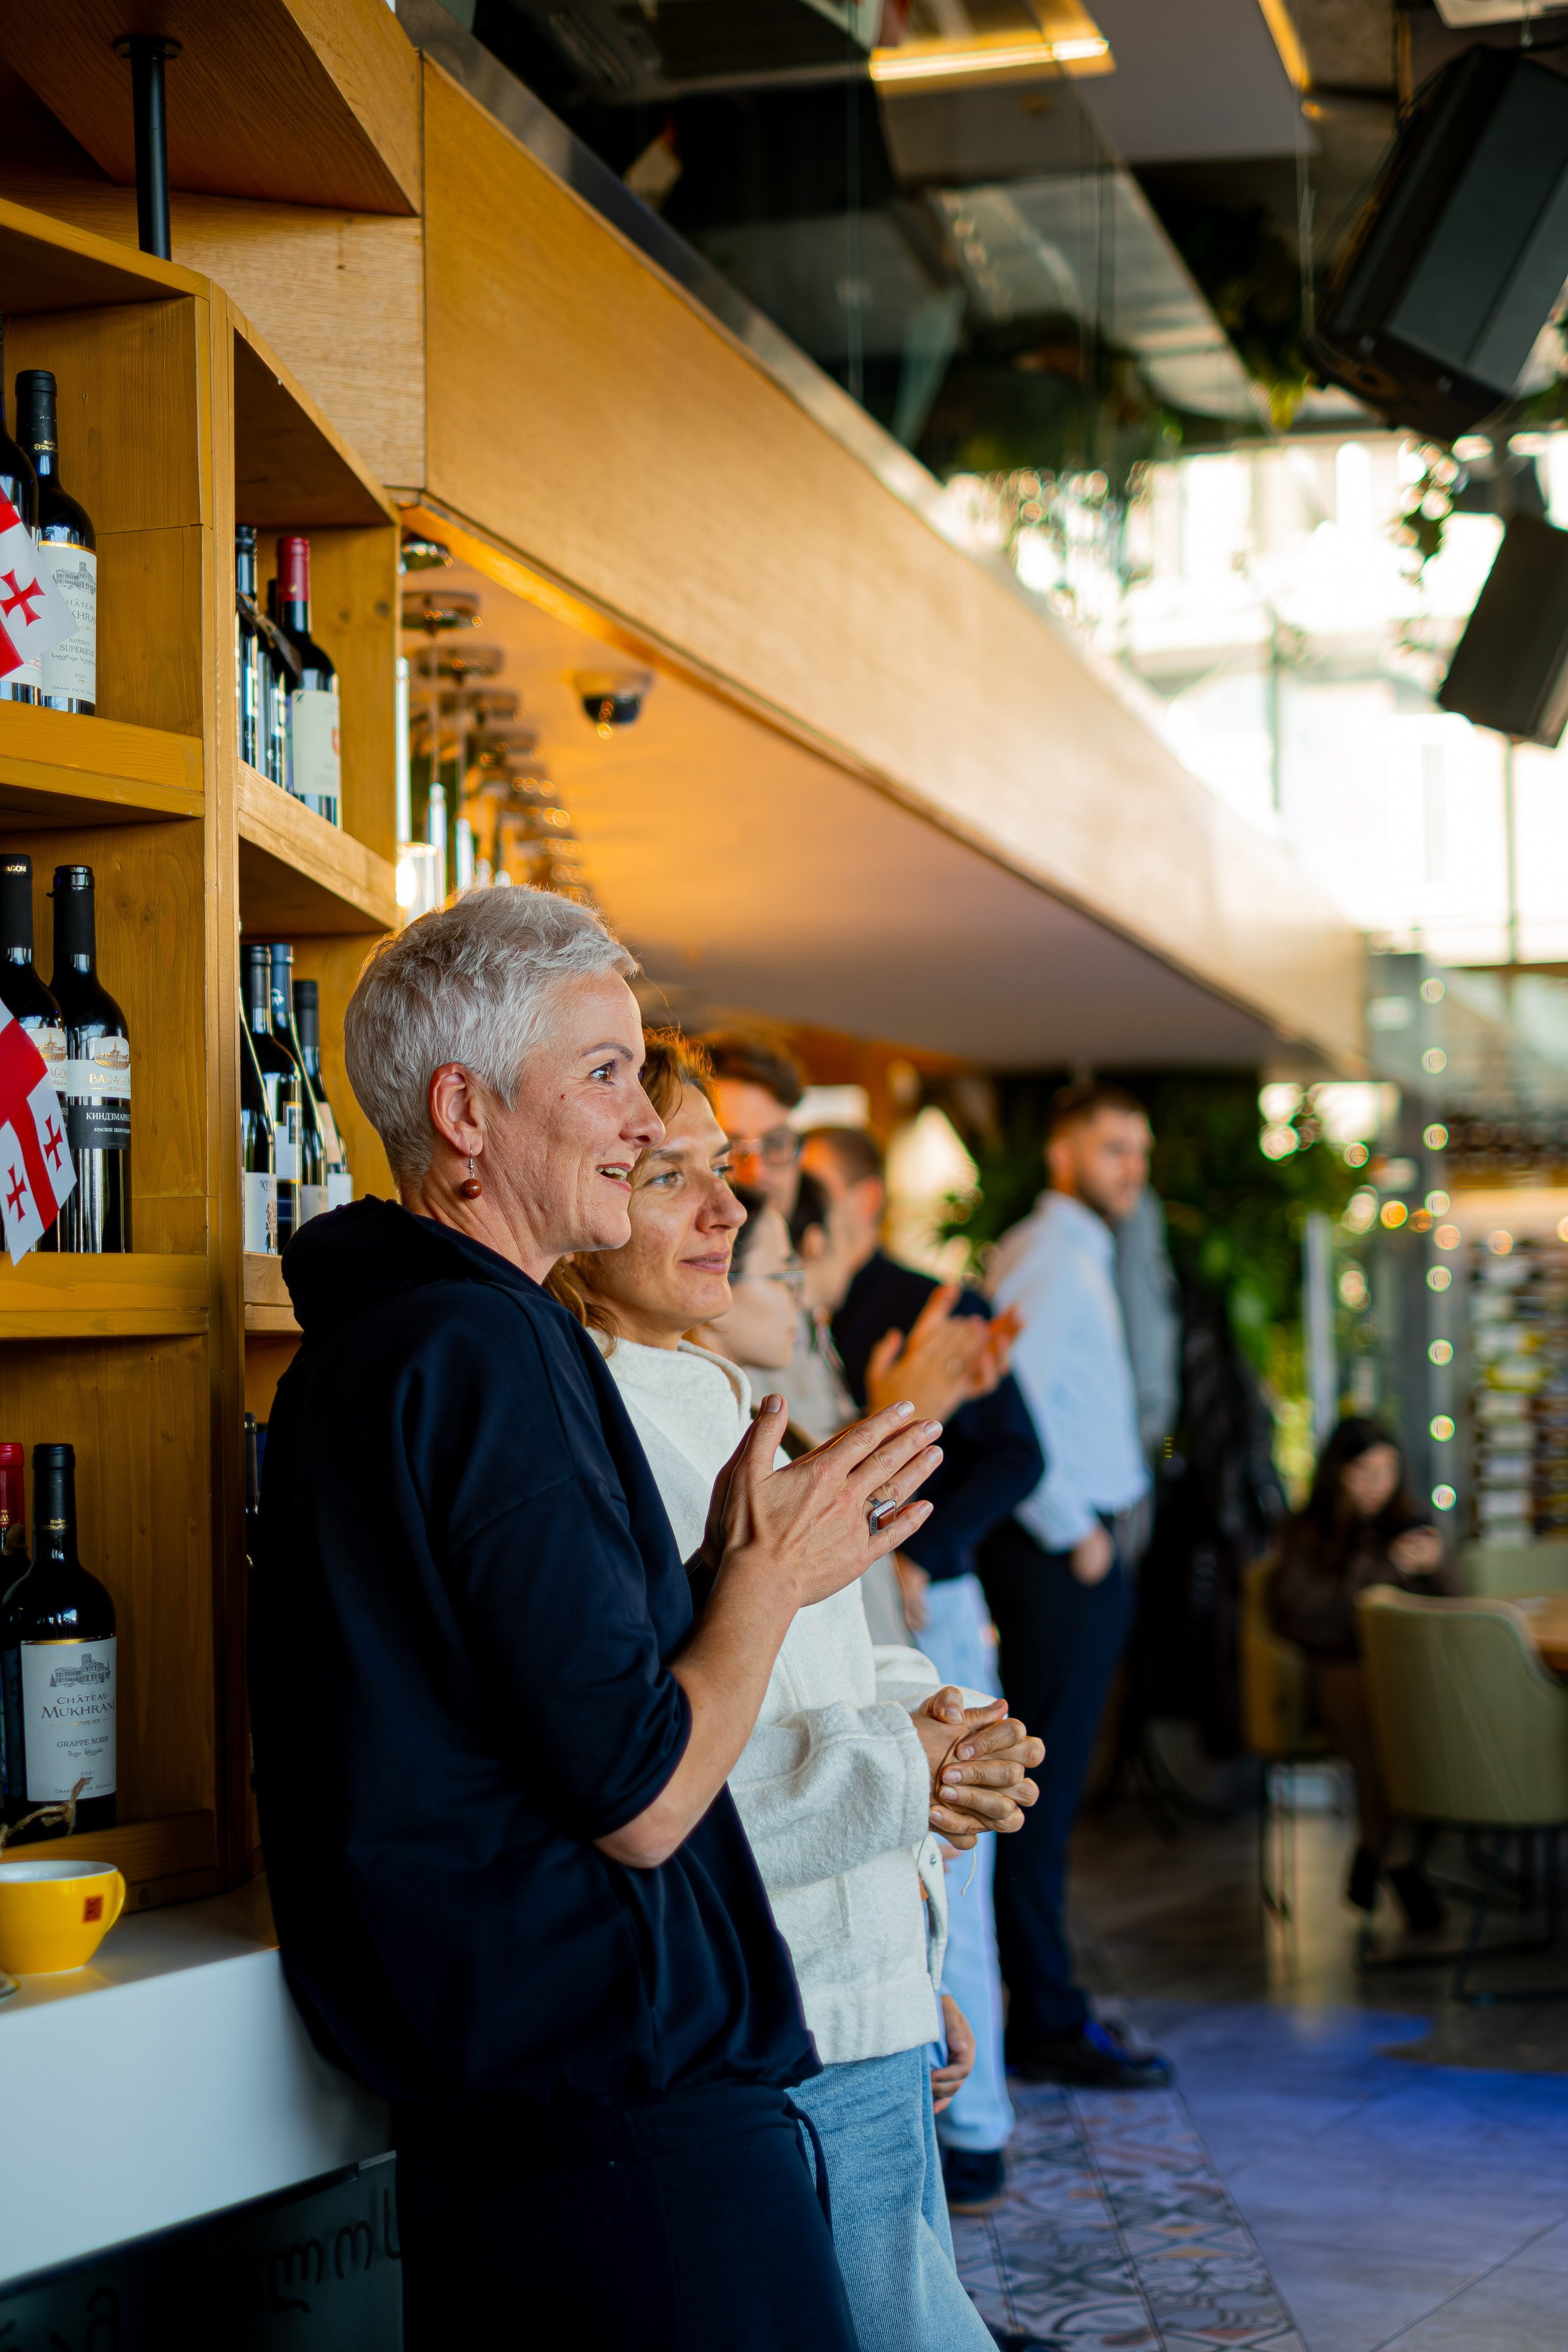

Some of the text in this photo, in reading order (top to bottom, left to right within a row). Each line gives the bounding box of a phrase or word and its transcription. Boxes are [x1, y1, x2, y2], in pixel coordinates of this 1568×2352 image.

[89, 1073, 131, 1086] BADAGO
[56, 1692, 108, 1705] CHÂTEAU
[40, 1698, 115, 1719] MUKHRAN
[56, 1735, 109, 1748] GRAPPE NOIRE
